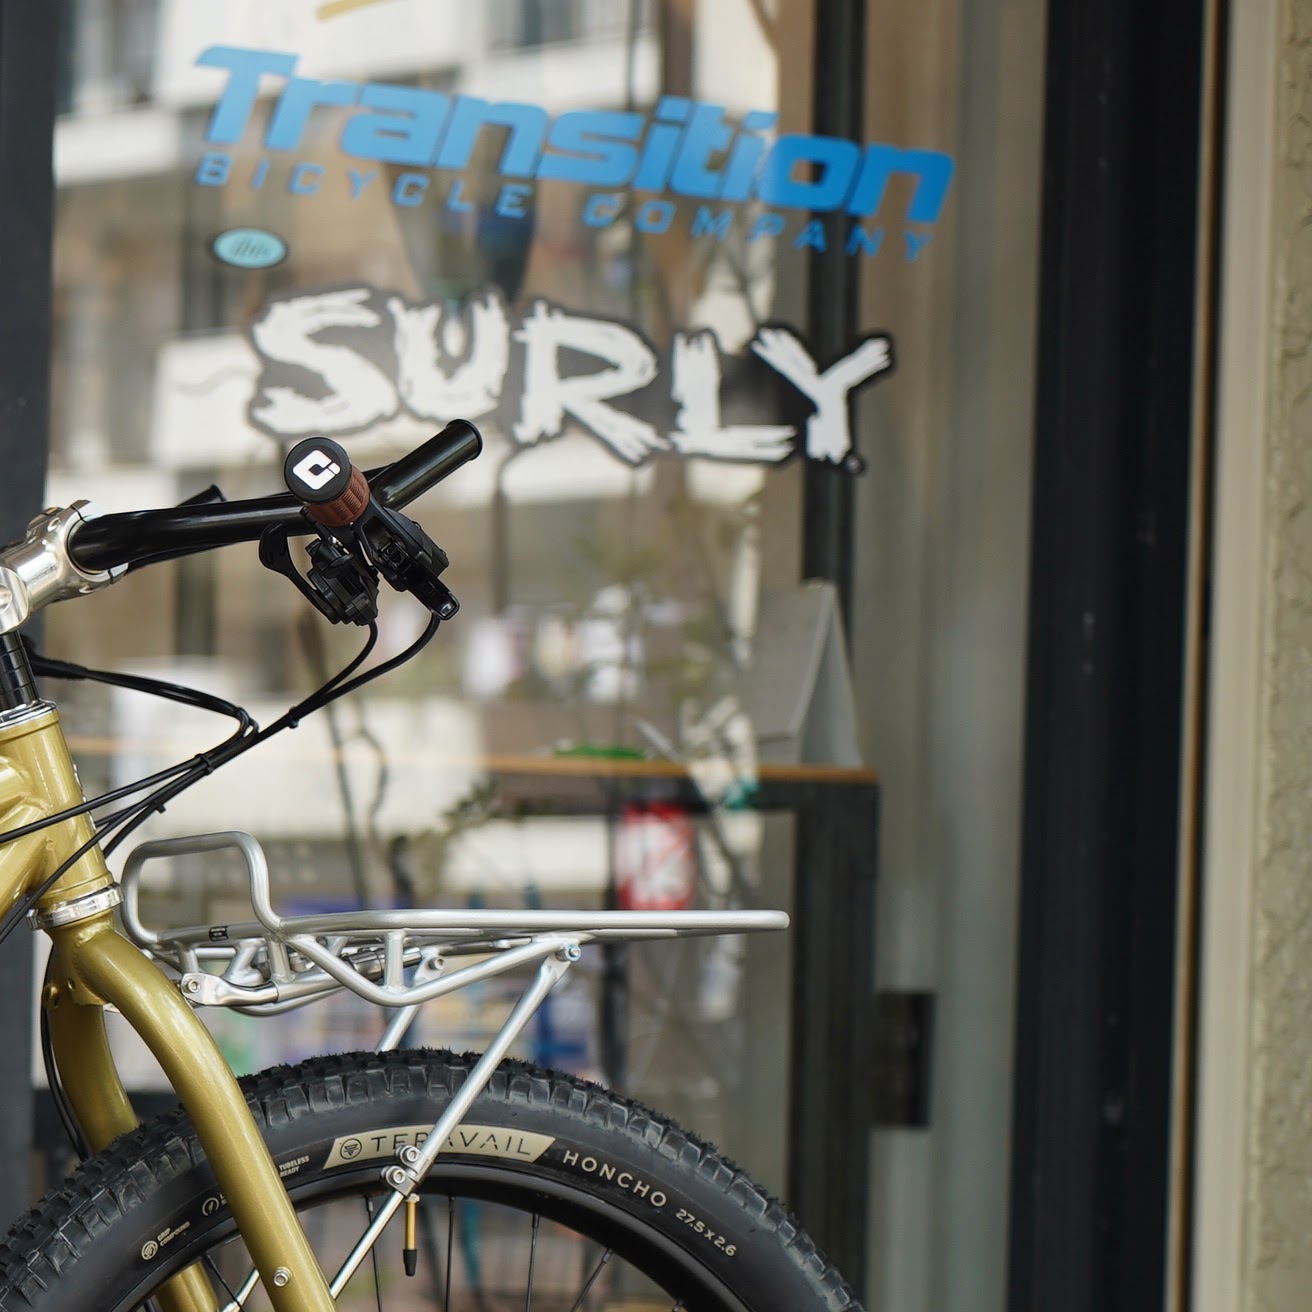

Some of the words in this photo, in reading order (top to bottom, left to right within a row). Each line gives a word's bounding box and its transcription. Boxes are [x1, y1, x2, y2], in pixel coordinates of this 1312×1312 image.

[195, 45, 956, 222] Transition
[196, 154, 531, 219] BICYCLE
[584, 193, 935, 262] COMPANY
[253, 288, 893, 466] SURLY
[278, 1155, 310, 1171] TUBELESS
[563, 1150, 667, 1207] HONCHO
